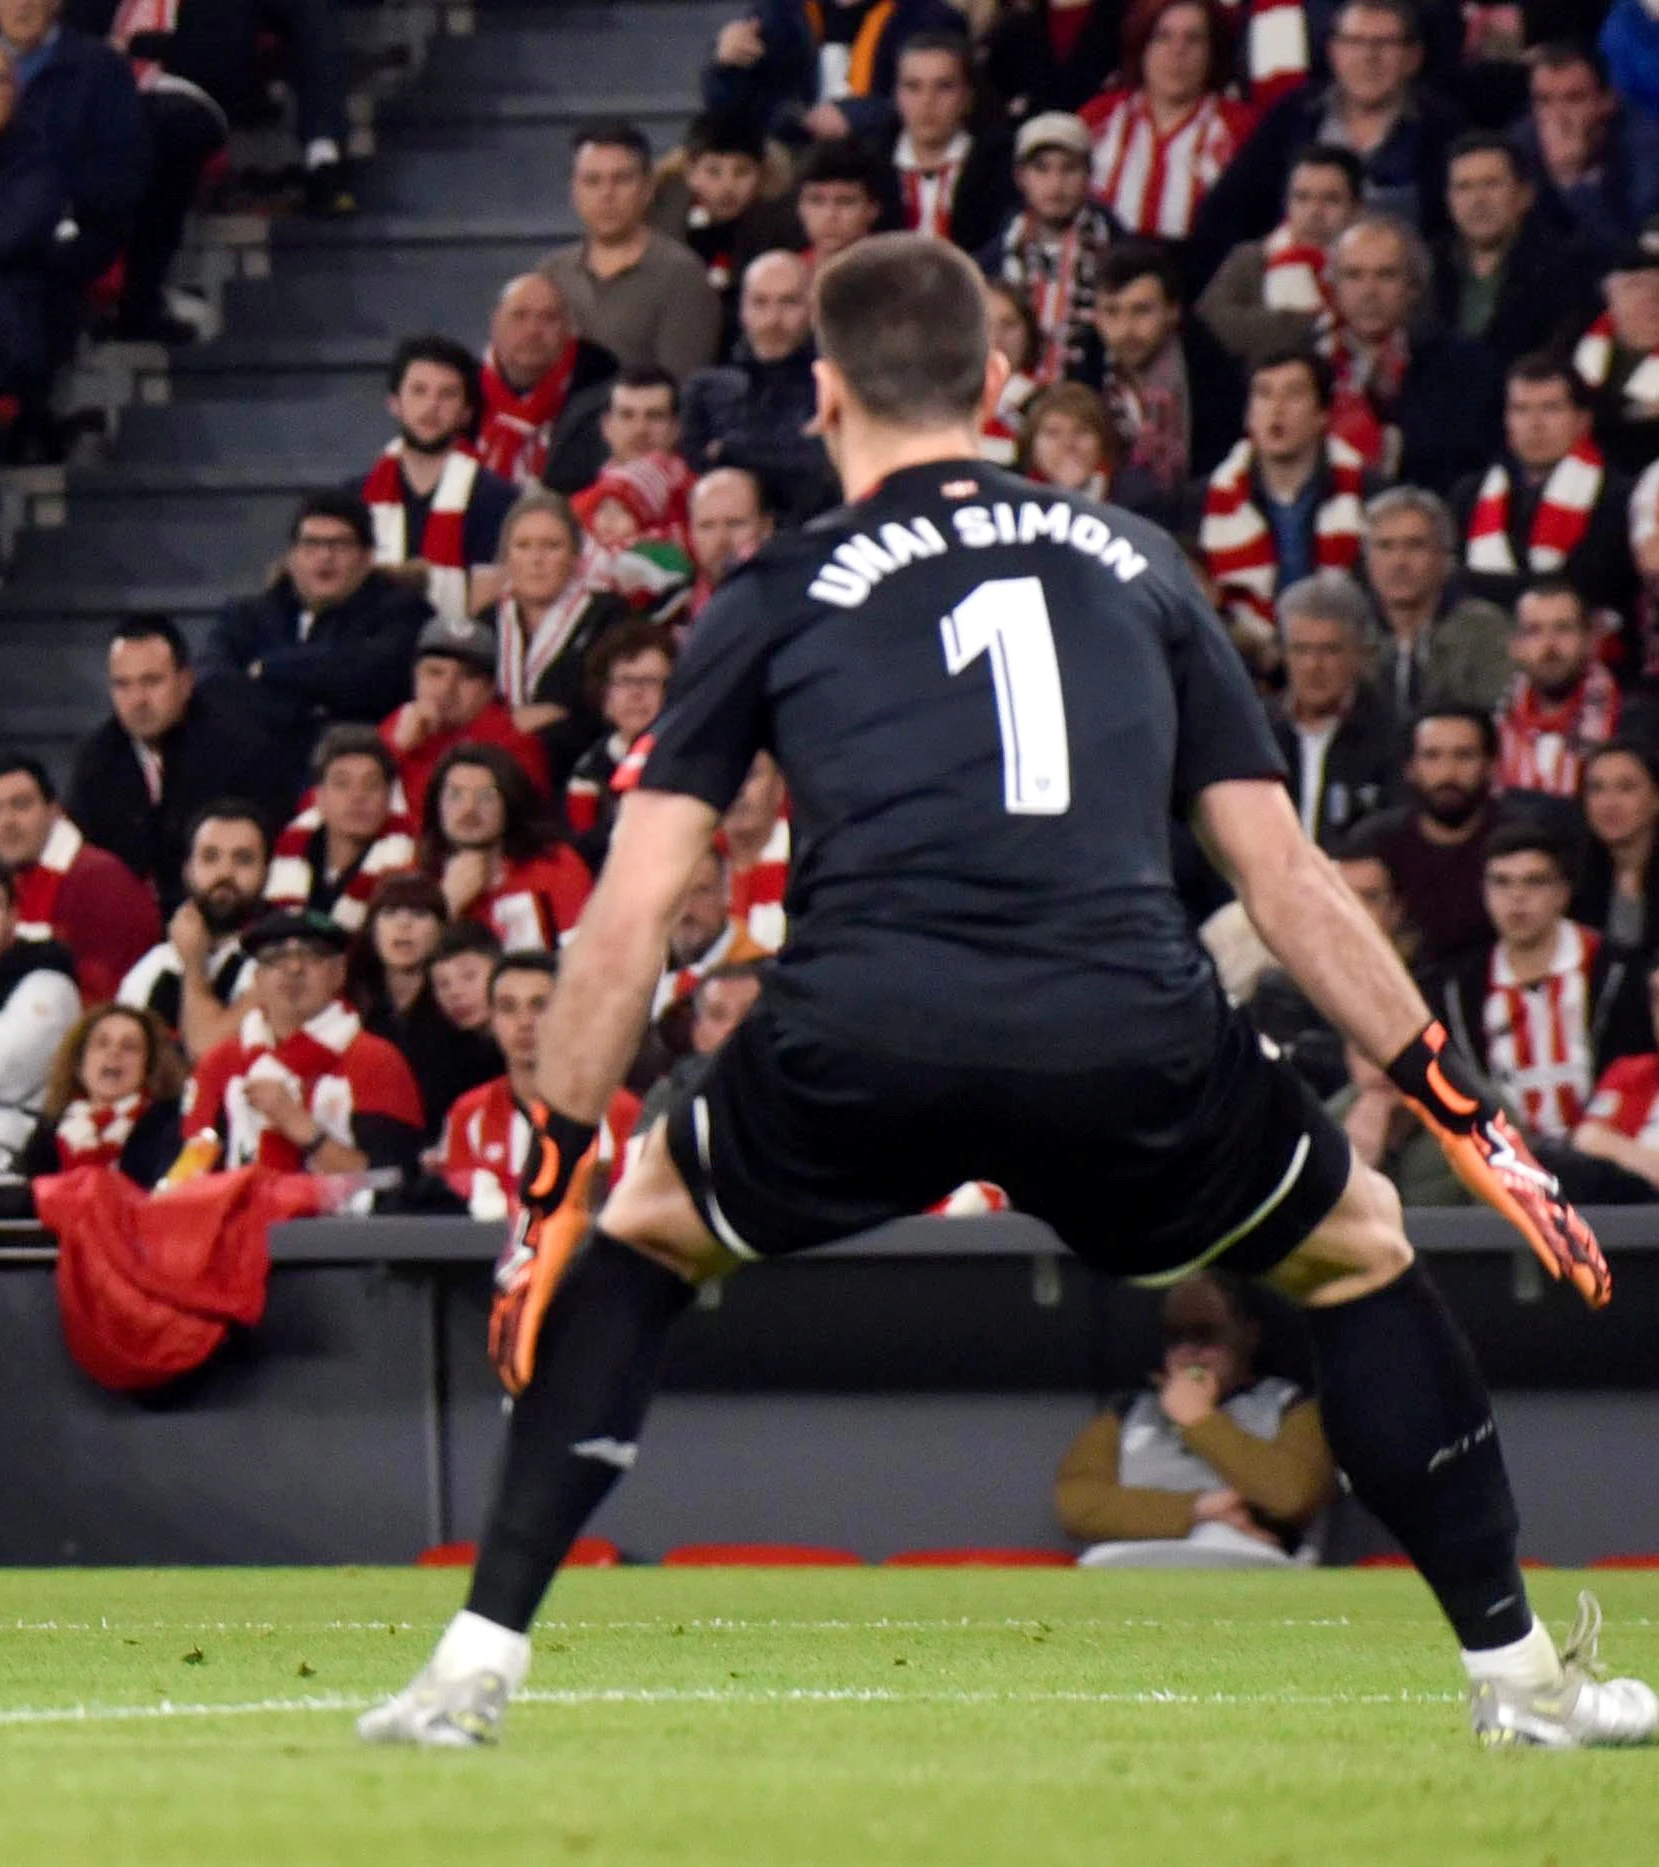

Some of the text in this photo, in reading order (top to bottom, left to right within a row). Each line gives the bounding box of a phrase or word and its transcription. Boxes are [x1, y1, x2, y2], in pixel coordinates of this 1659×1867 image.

[808, 502, 1148, 608] UNAI SIMON
[940, 576, 1070, 815] 1
